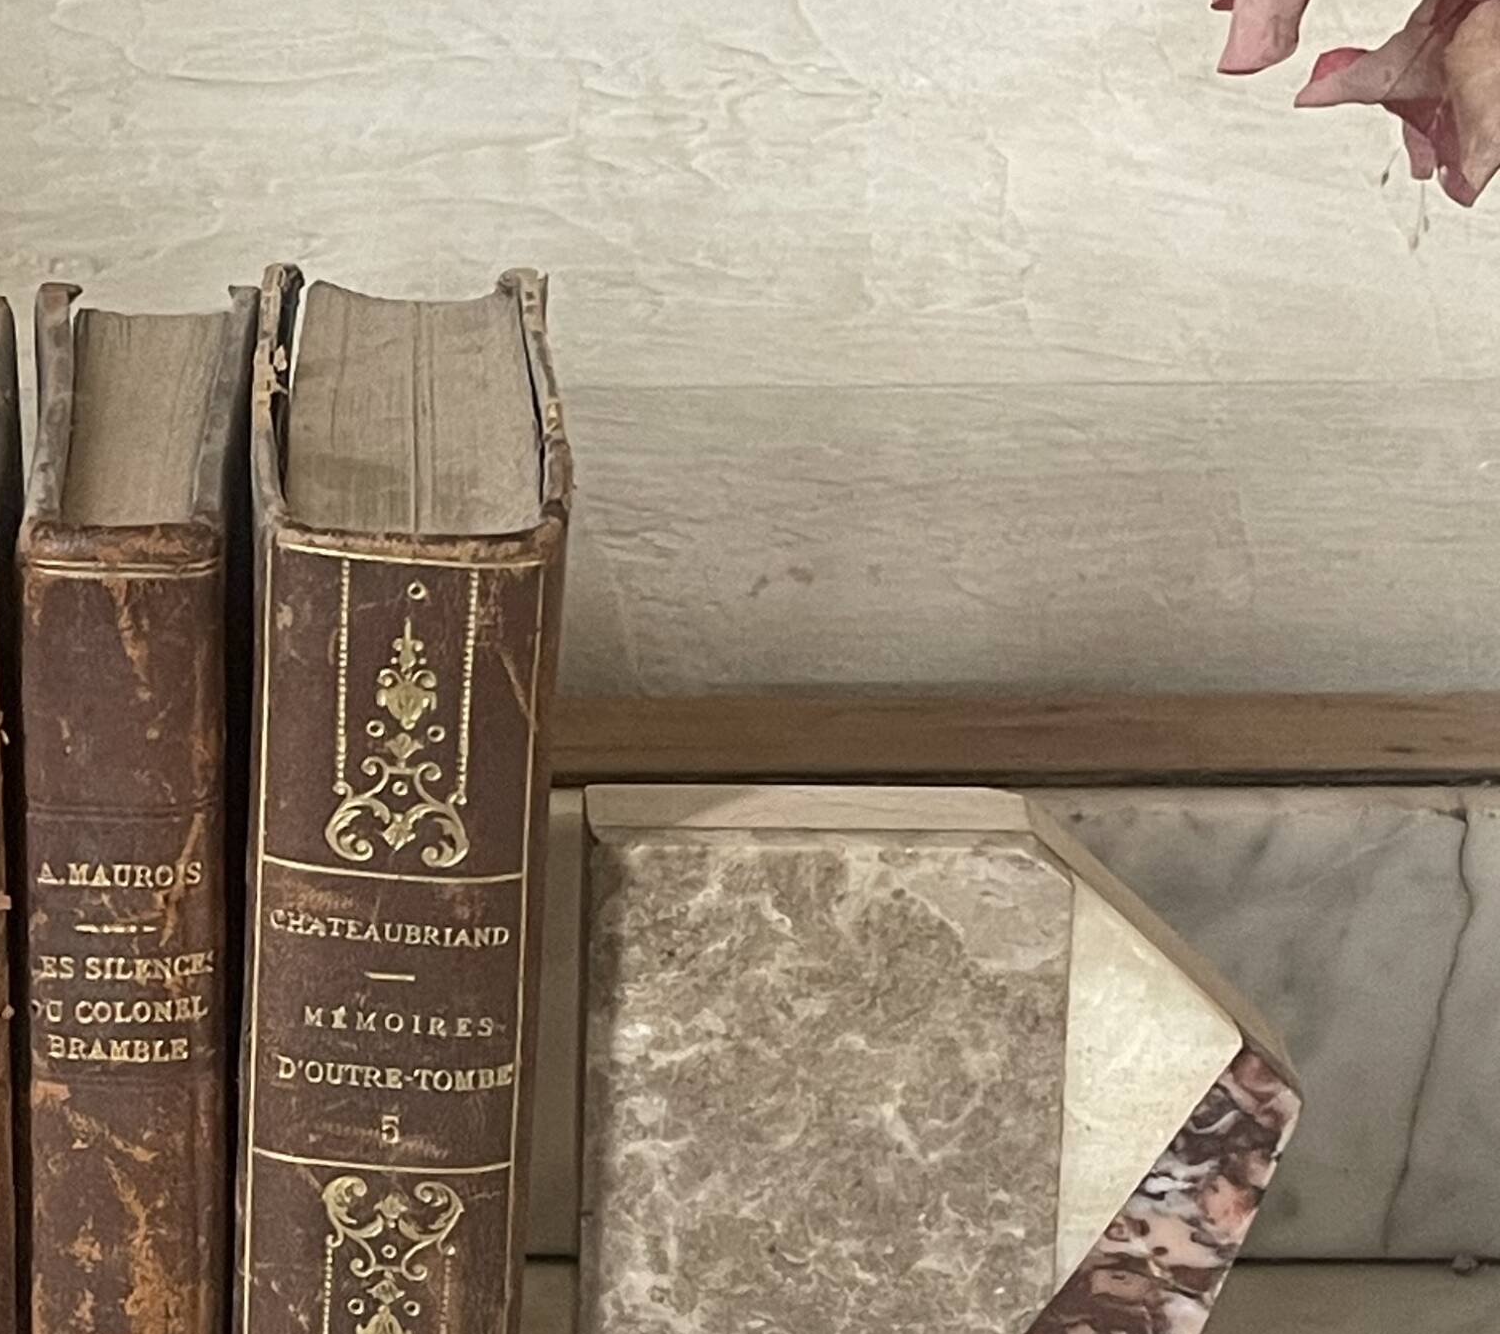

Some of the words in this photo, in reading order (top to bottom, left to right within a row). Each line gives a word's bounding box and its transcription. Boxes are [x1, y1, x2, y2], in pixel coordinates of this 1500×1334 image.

[38, 861, 202, 888] A.MAUROIS
[269, 908, 510, 948] CHATEAUBRIAND
[75, 995, 208, 1024] COLONEL
[47, 1034, 189, 1063] BRAMBLE
[276, 1053, 514, 1092] D'OUTRE-TOMBE
[380, 1114, 401, 1145] 5
